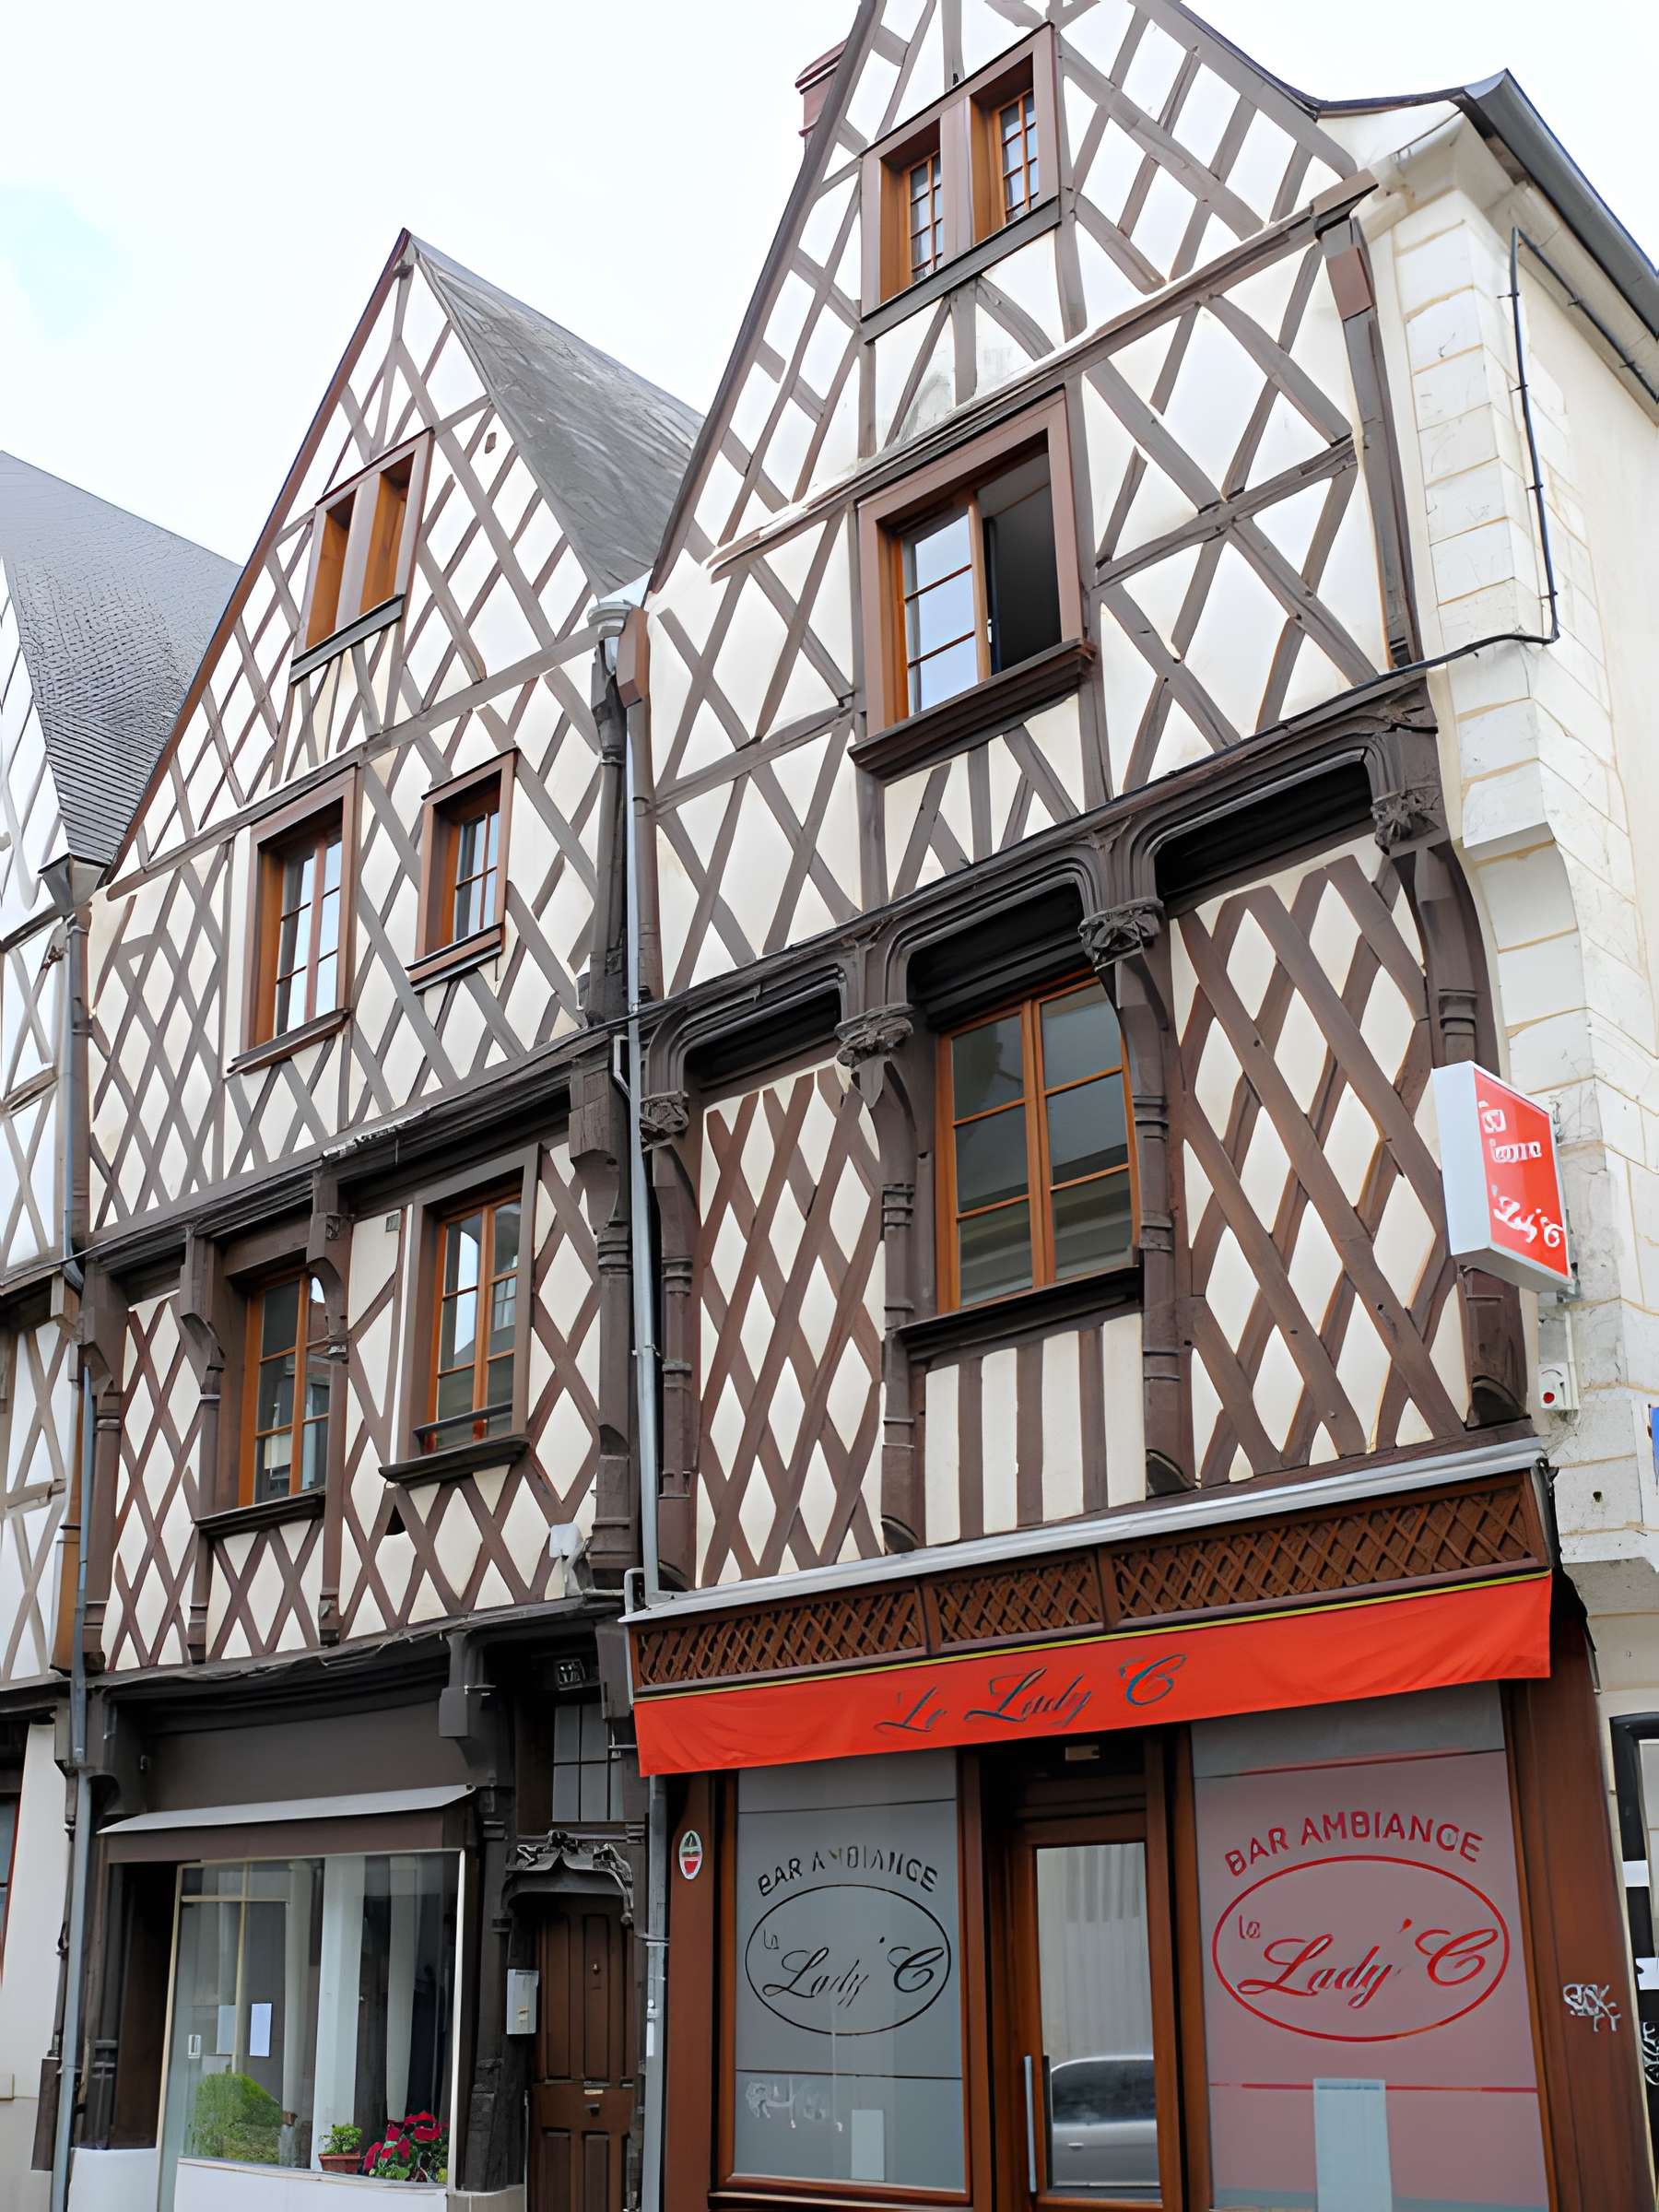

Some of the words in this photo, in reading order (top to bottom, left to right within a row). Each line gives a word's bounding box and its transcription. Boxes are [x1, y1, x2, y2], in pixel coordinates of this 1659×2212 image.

[964, 1666, 1092, 1729] Lady
[1224, 1827, 1290, 1877] BAR
[1300, 1810, 1483, 1864] AMBIANCE
[758, 1858, 803, 1897] BAR
